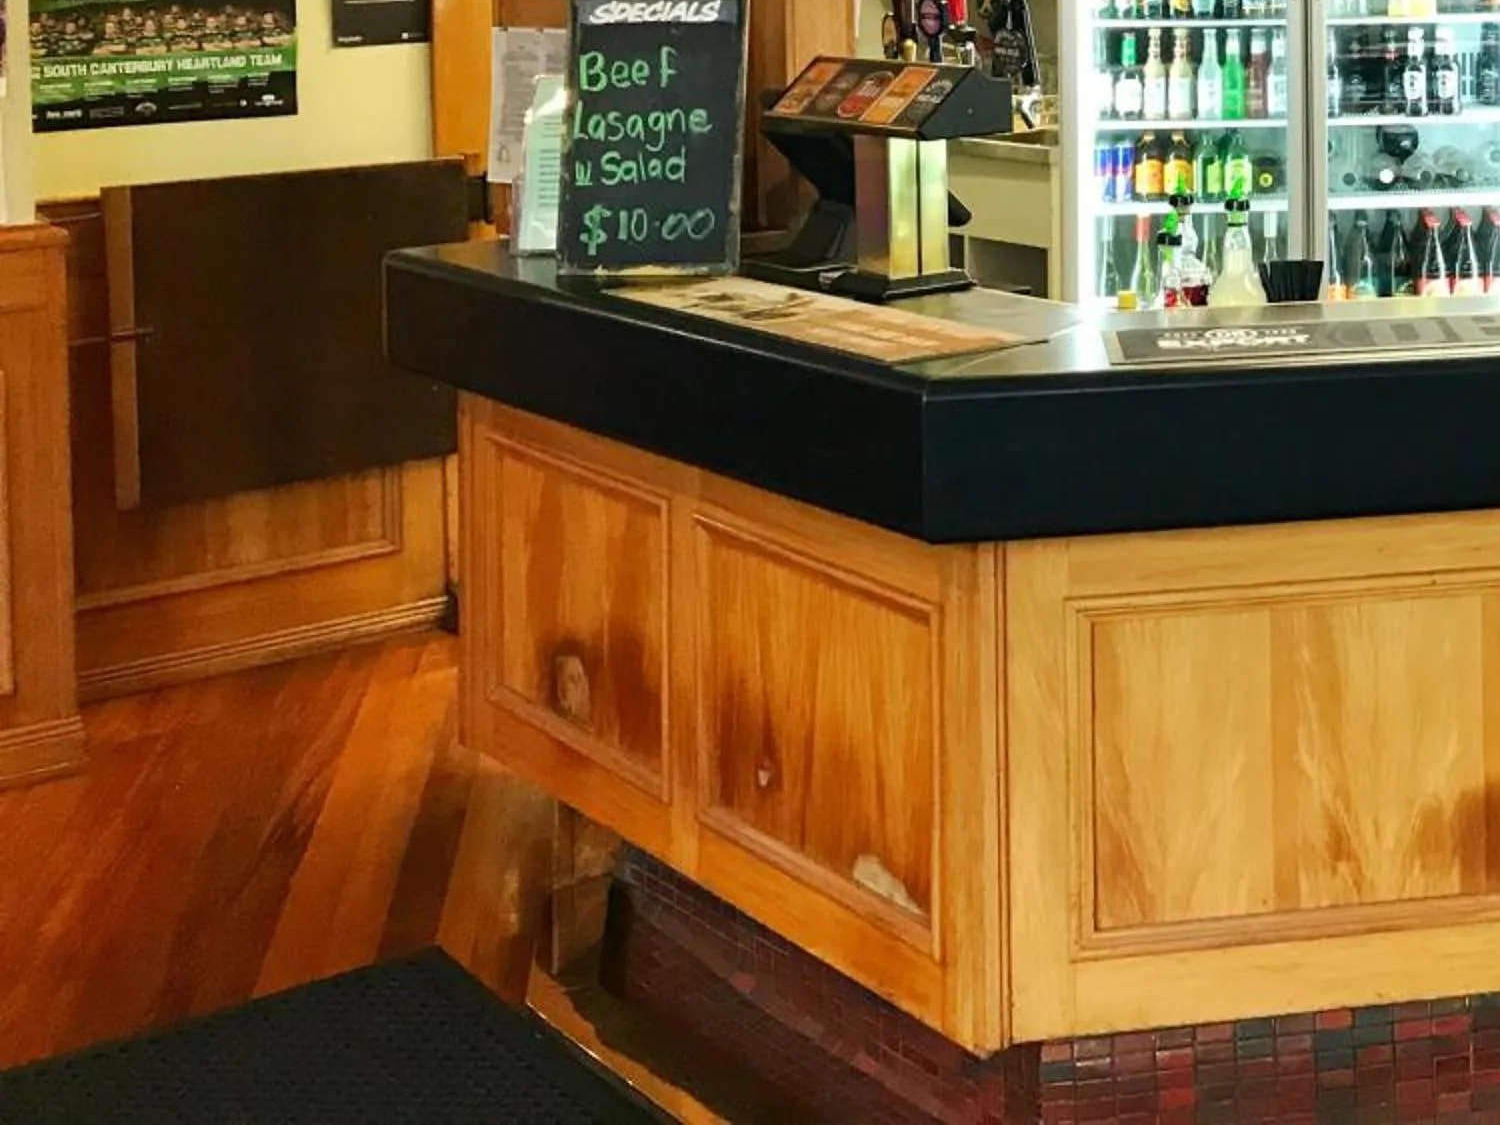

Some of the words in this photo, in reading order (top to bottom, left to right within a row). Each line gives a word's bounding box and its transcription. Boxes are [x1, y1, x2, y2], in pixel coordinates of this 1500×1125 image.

[43, 62, 87, 77] SOUTH
[89, 59, 175, 76] CANTERBURY
[176, 55, 247, 70] HEARTLAND
[250, 54, 283, 66] TEAM
[578, 46, 678, 92] Beef
[573, 102, 713, 151] Lasagne
[601, 148, 687, 184] Salad
